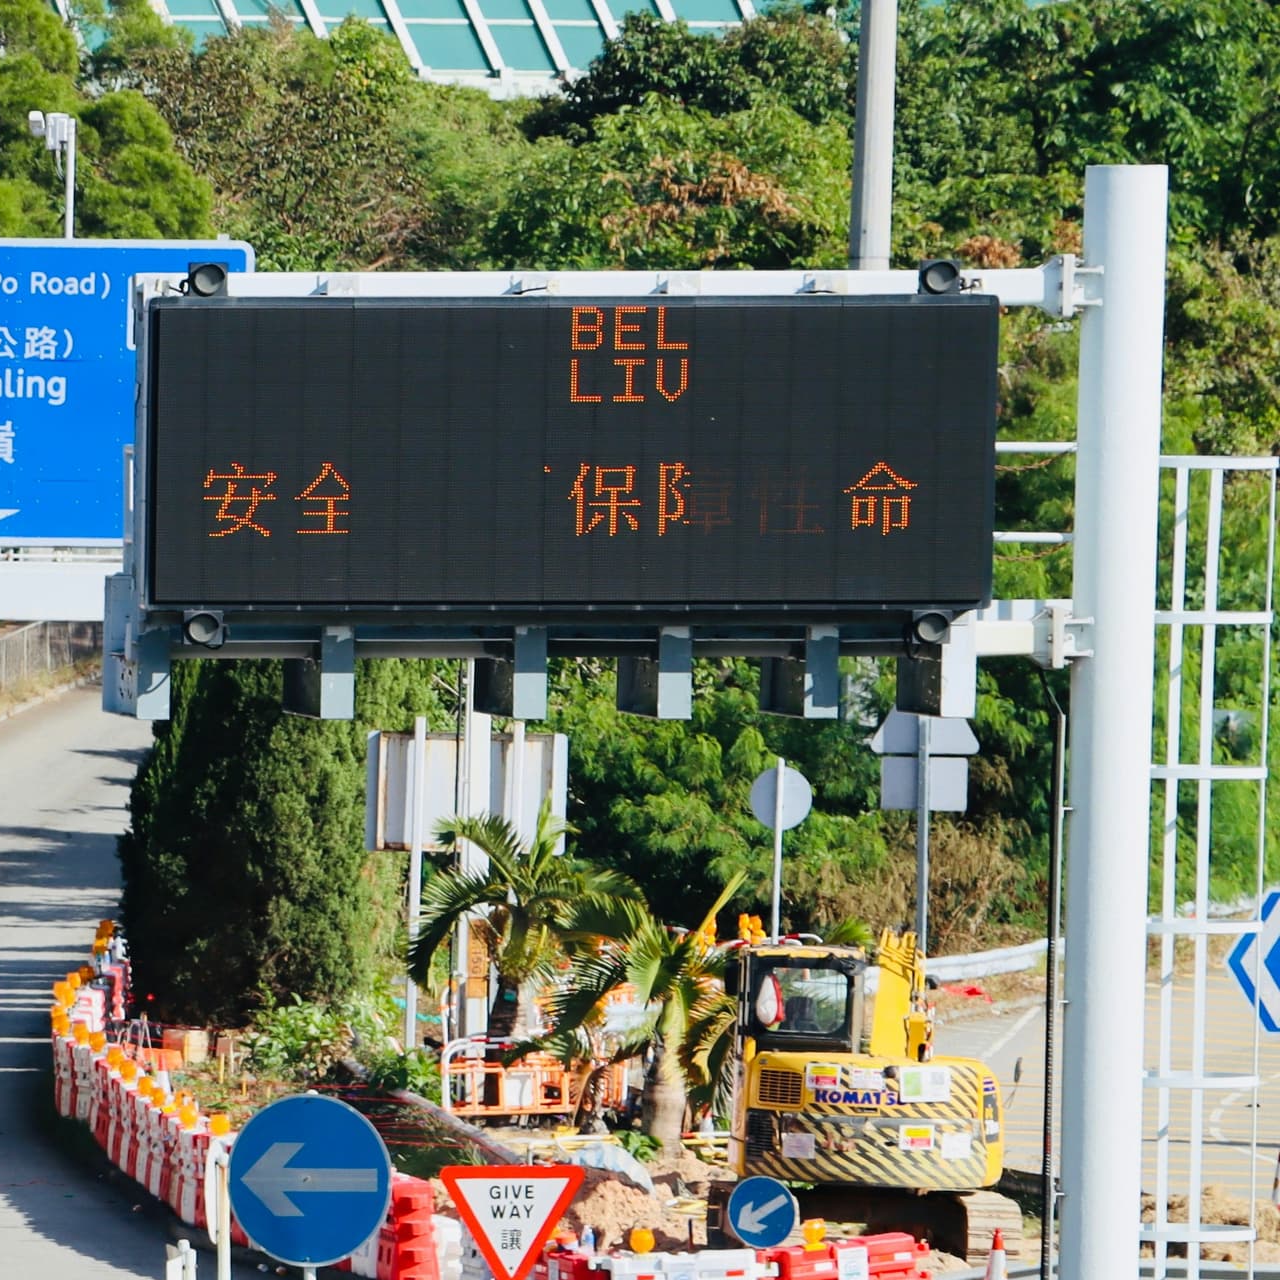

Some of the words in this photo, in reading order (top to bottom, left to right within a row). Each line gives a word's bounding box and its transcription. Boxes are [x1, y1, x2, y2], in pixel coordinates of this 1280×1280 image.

[31, 272, 111, 299] Road)
[571, 305, 690, 350] BEL
[569, 358, 690, 403] LIV
[203, 462, 351, 538] 安全
[489, 1185, 535, 1200] GIVE
[491, 1205, 534, 1219] WAY
[501, 1229, 522, 1252] 讓
